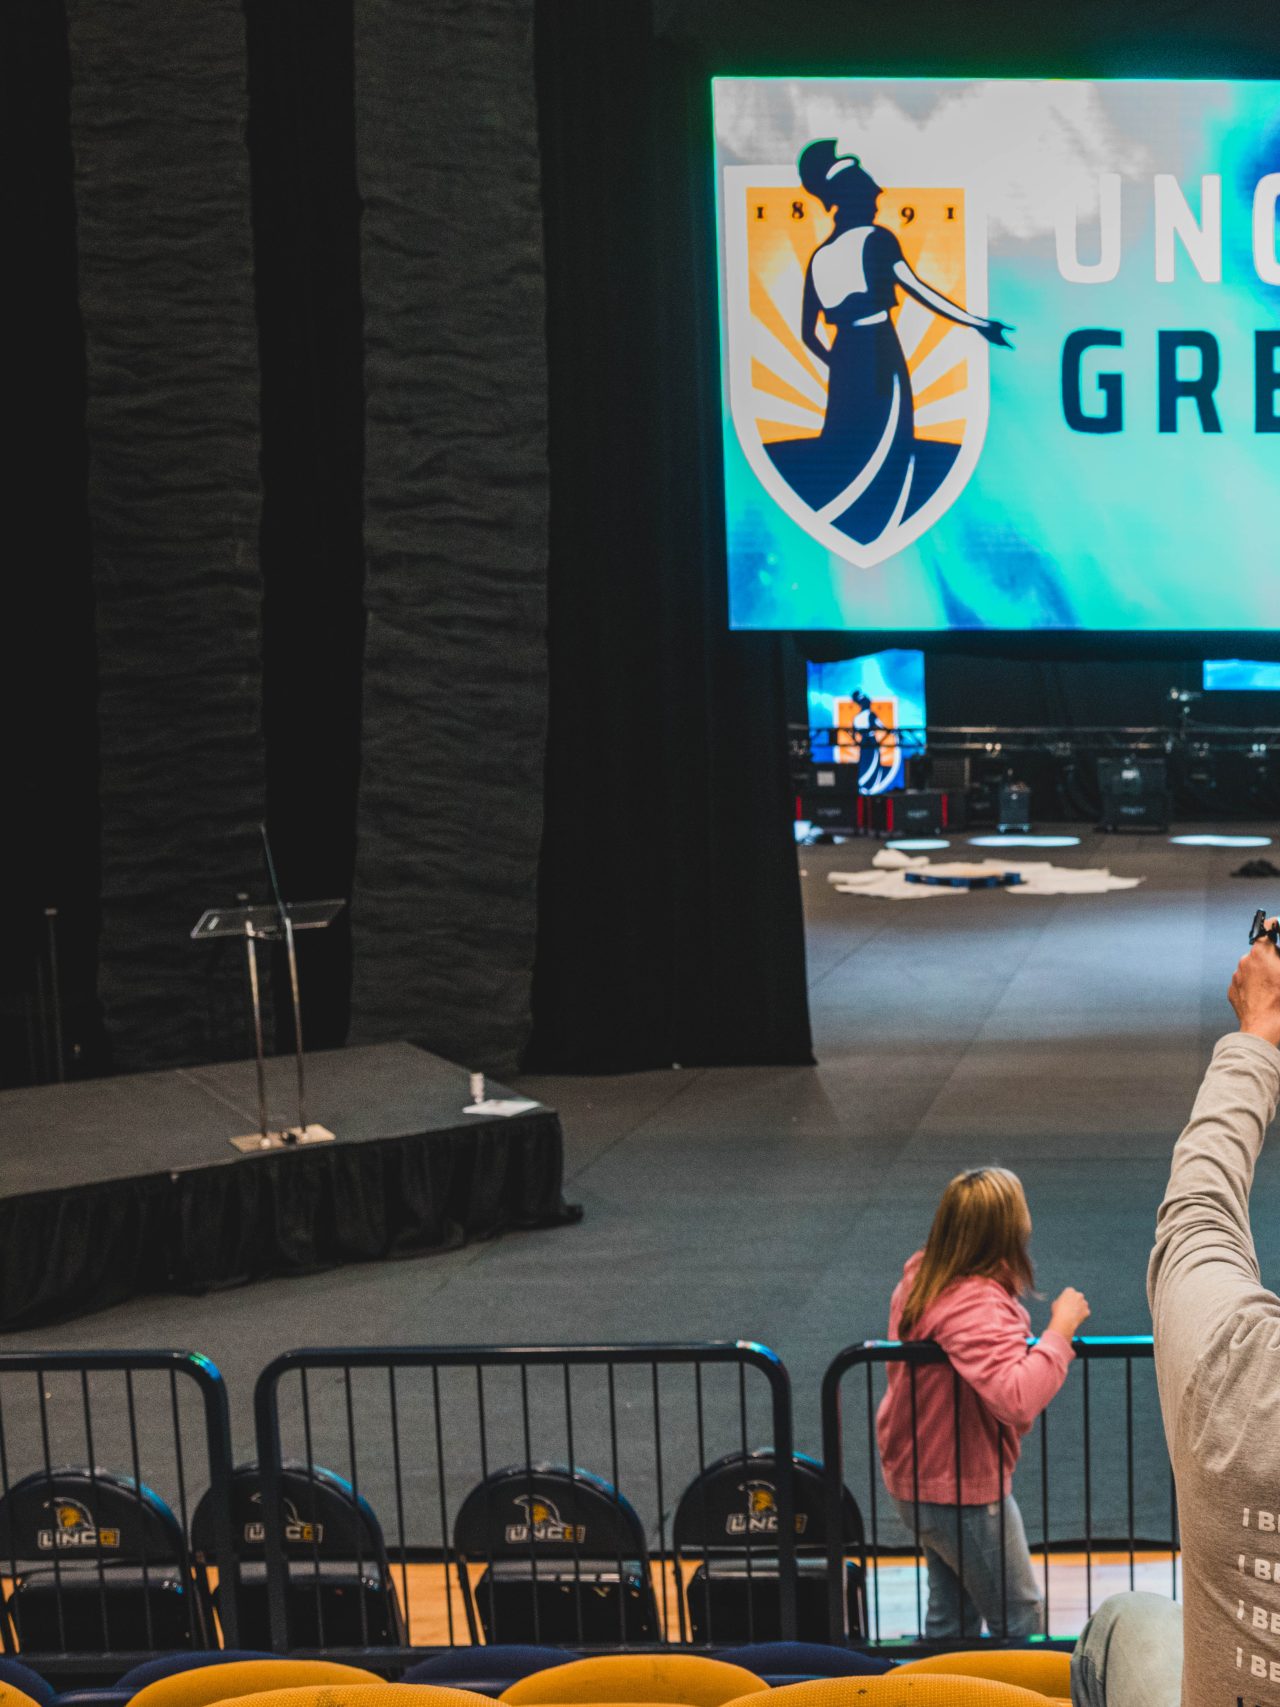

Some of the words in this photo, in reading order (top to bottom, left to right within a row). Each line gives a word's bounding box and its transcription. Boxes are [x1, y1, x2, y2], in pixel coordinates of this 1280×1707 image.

[1242, 1508, 1250, 1527] I
[1238, 1555, 1246, 1574] I
[1237, 1599, 1245, 1621] I
[1236, 1647, 1243, 1669] I
